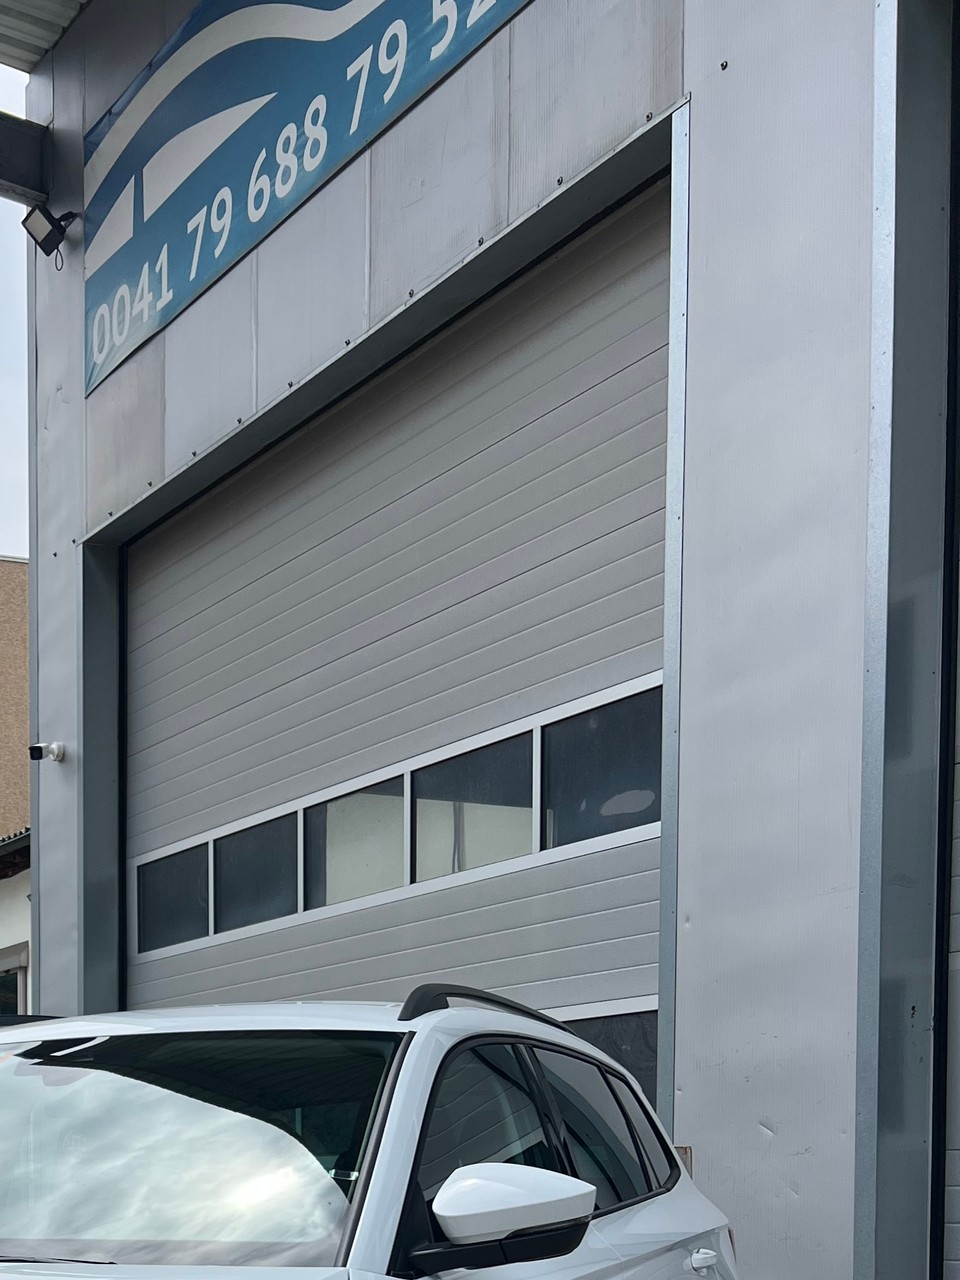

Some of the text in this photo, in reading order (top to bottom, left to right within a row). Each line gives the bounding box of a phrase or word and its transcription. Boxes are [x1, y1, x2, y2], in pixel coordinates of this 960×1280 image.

[92, 242, 174, 365] 0041
[186, 185, 233, 282] 79
[247, 94, 328, 223] 688
[346, 18, 408, 136] 79
